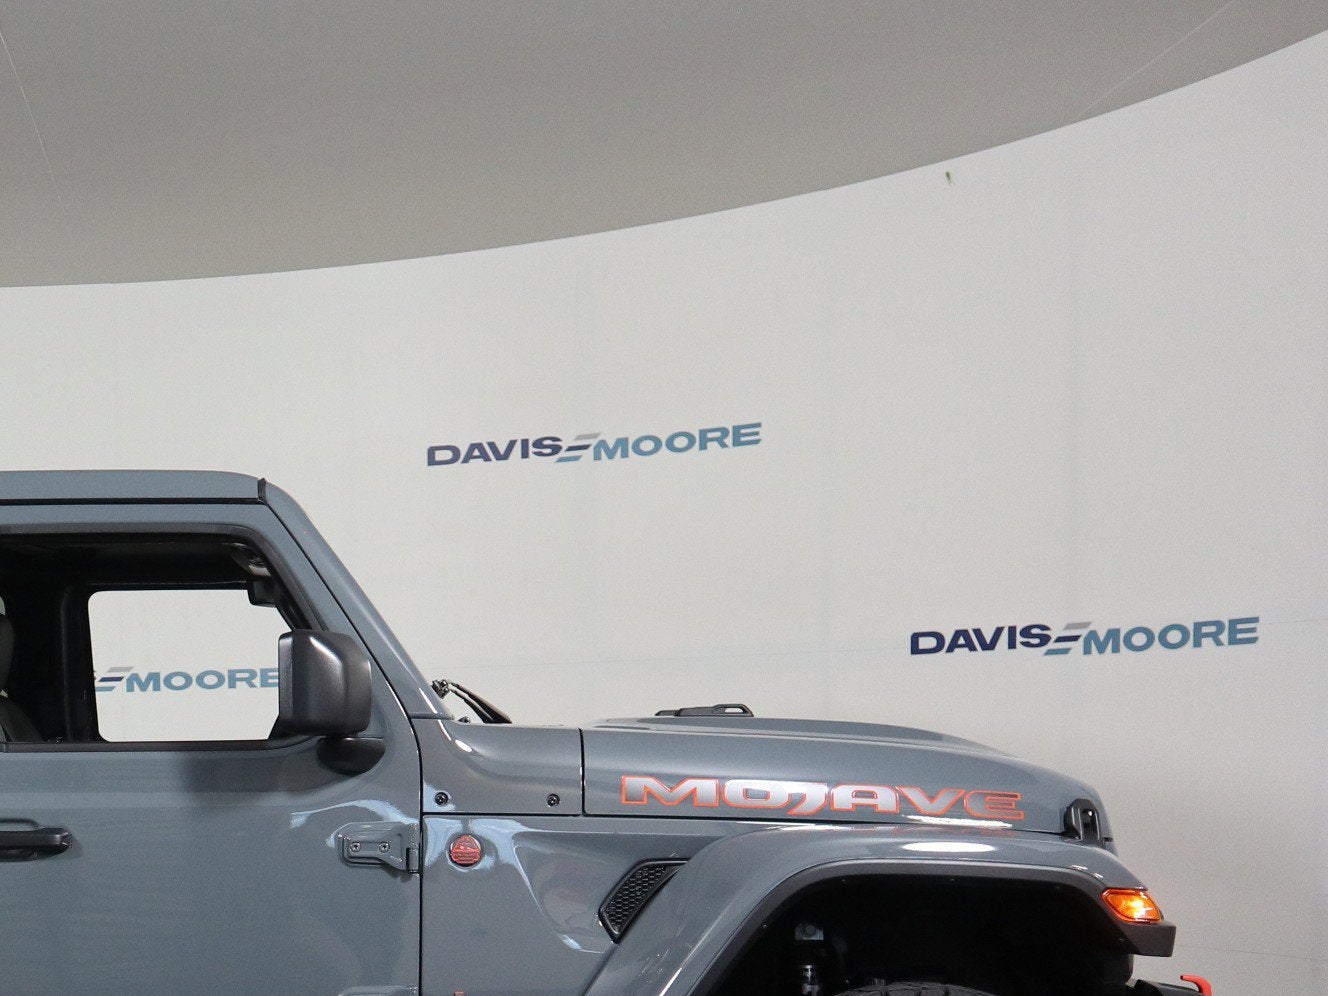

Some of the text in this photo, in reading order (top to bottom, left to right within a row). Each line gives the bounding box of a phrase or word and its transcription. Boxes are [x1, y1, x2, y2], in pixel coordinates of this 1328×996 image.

[427, 422, 762, 466] DAVIS MOORE
[910, 616, 1259, 655] DAVIS MOORE
[621, 775, 1025, 820] MOJAVE
